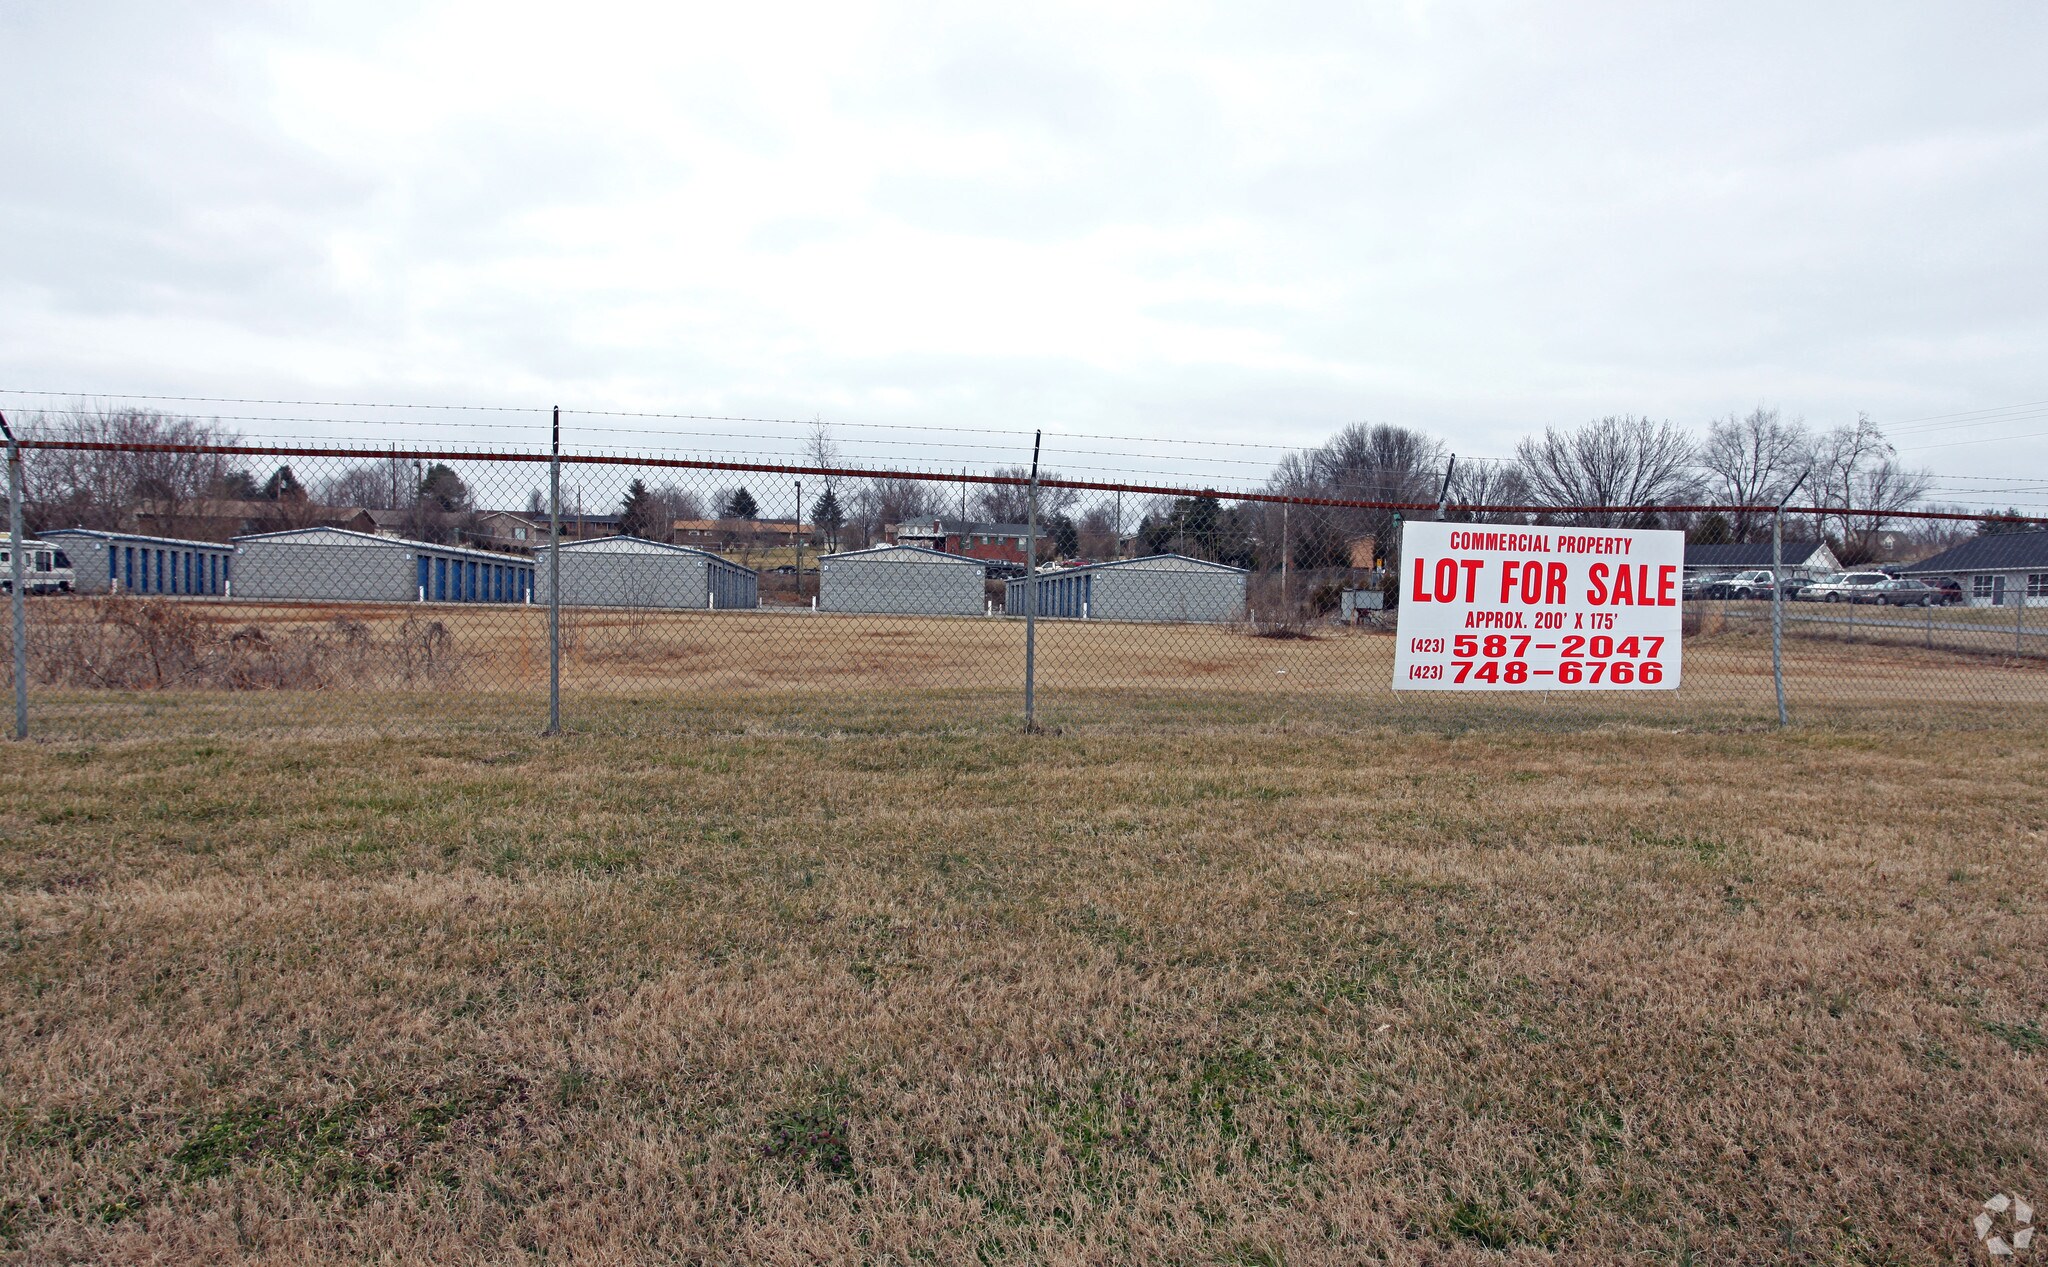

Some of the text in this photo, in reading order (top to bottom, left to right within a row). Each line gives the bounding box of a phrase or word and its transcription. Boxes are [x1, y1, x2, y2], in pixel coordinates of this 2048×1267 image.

[1450, 531, 1633, 555] COMMERCIAL PROPERTY
[1412, 557, 1677, 607] LOT FOR SALE
[1465, 610, 1618, 630] APPROX. 200' X 175'
[1411, 634, 1665, 659] (423) 587-2047
[1409, 661, 1663, 685] (423) 748-6766
